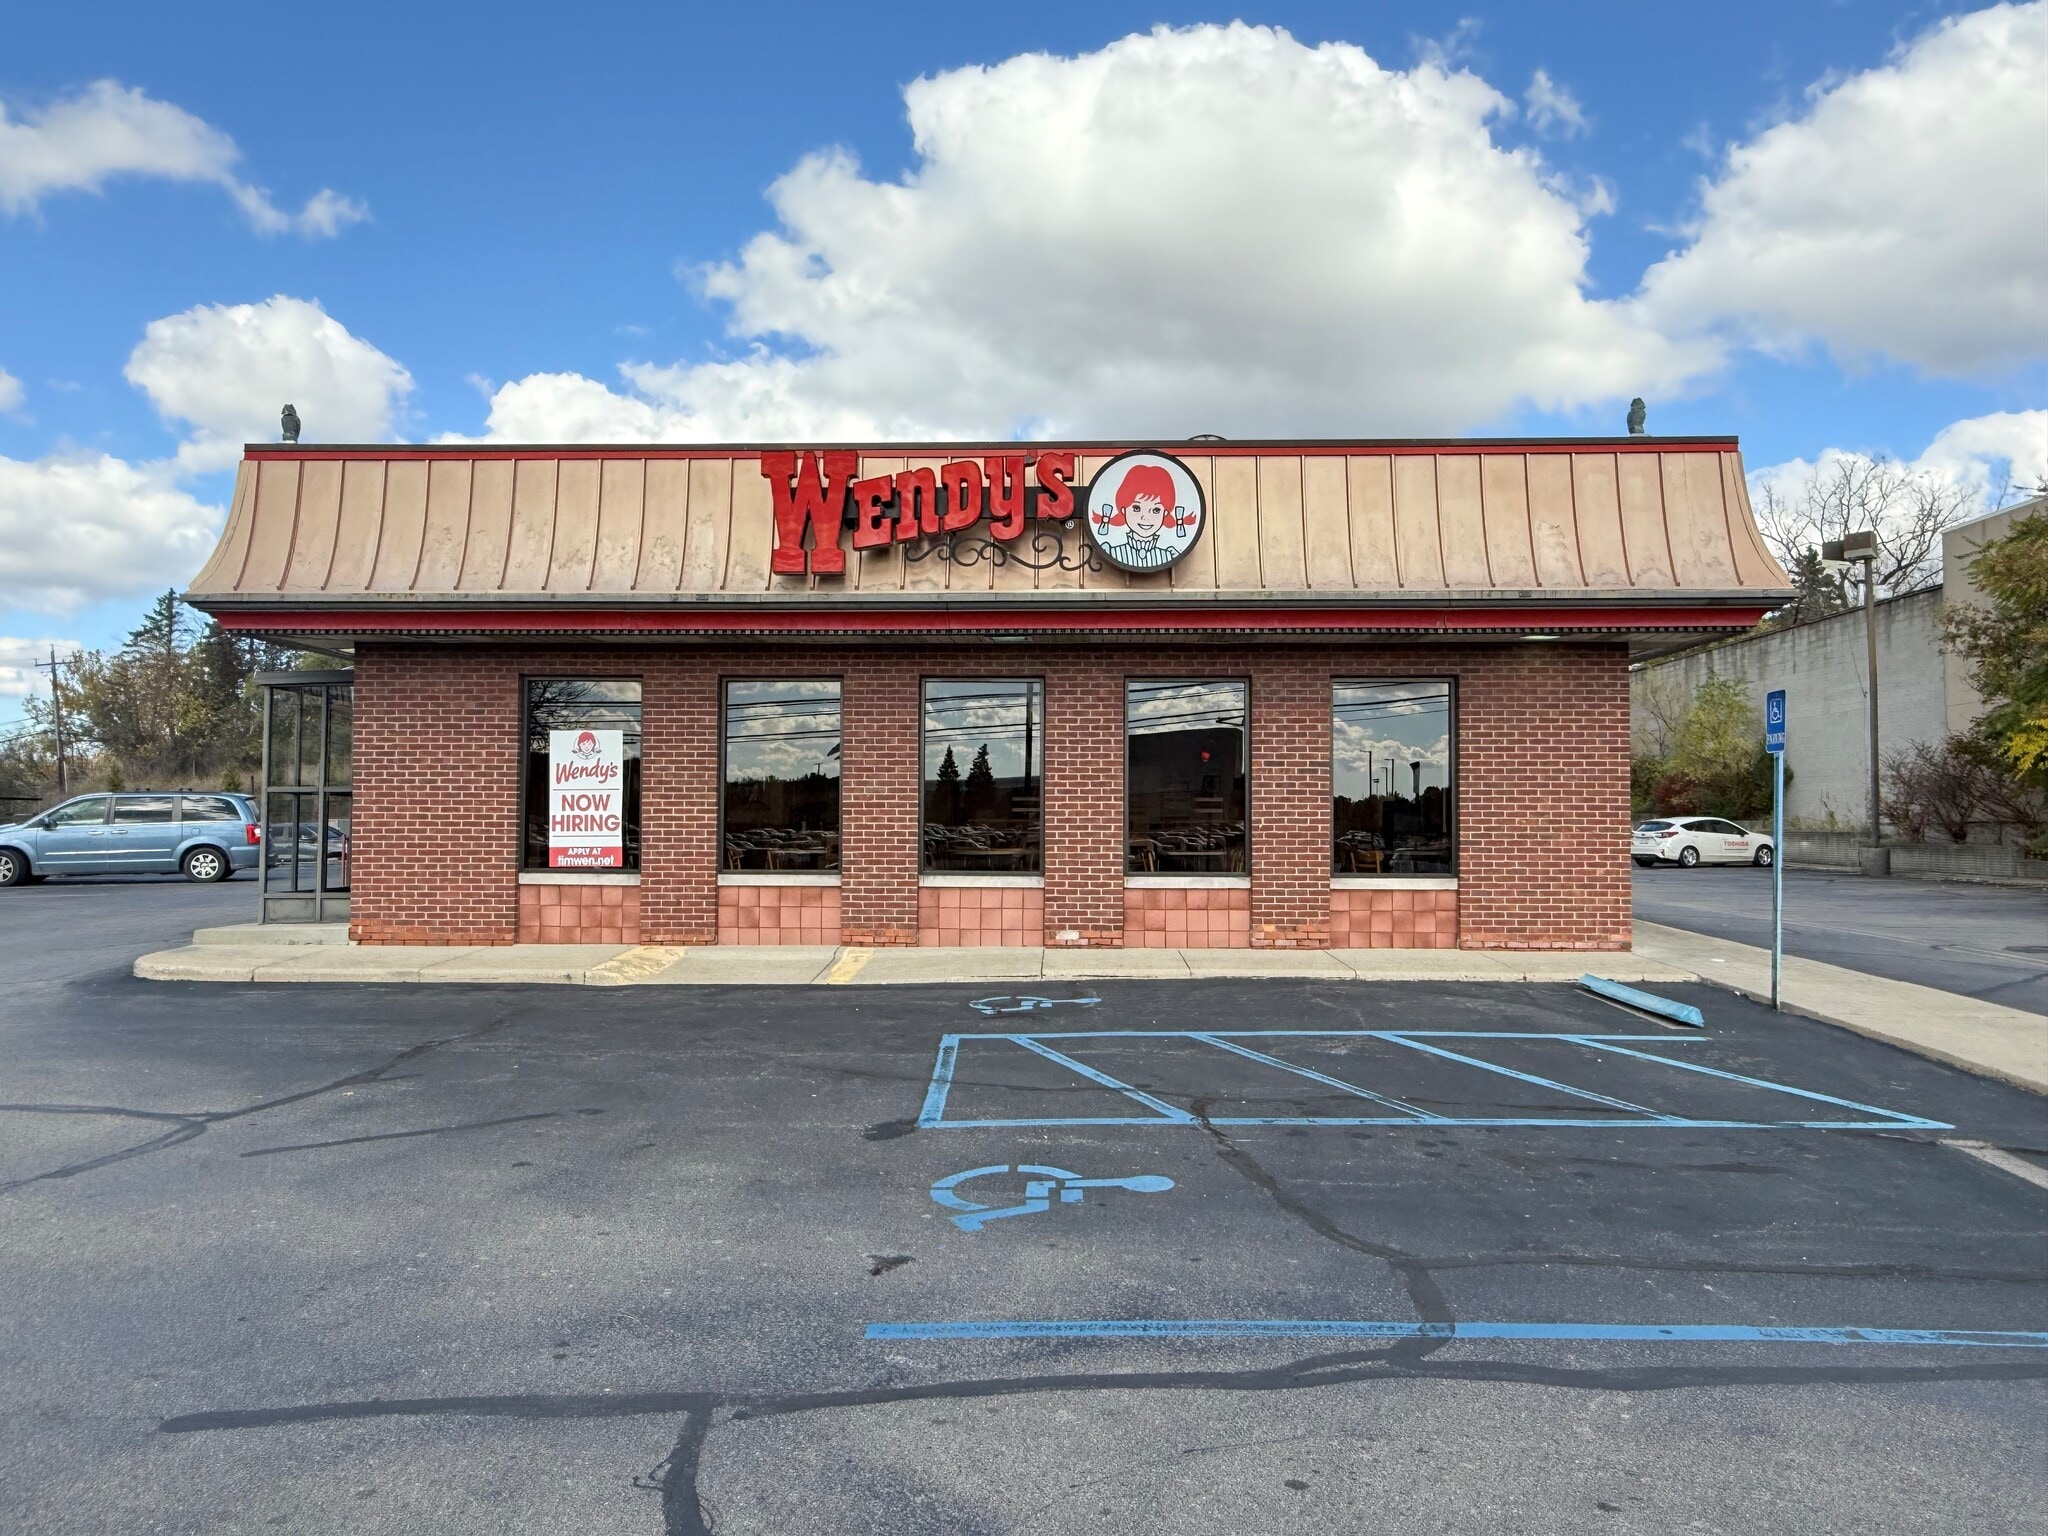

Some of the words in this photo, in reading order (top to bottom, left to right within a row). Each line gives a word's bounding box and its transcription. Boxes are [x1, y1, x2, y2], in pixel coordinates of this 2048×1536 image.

[556, 758, 618, 784] Wendy's
[562, 794, 611, 811] NOW
[551, 814, 620, 832] HIRING
[567, 847, 589, 855] APPLY
[592, 847, 602, 855] AT
[558, 855, 614, 866] timwen.net
